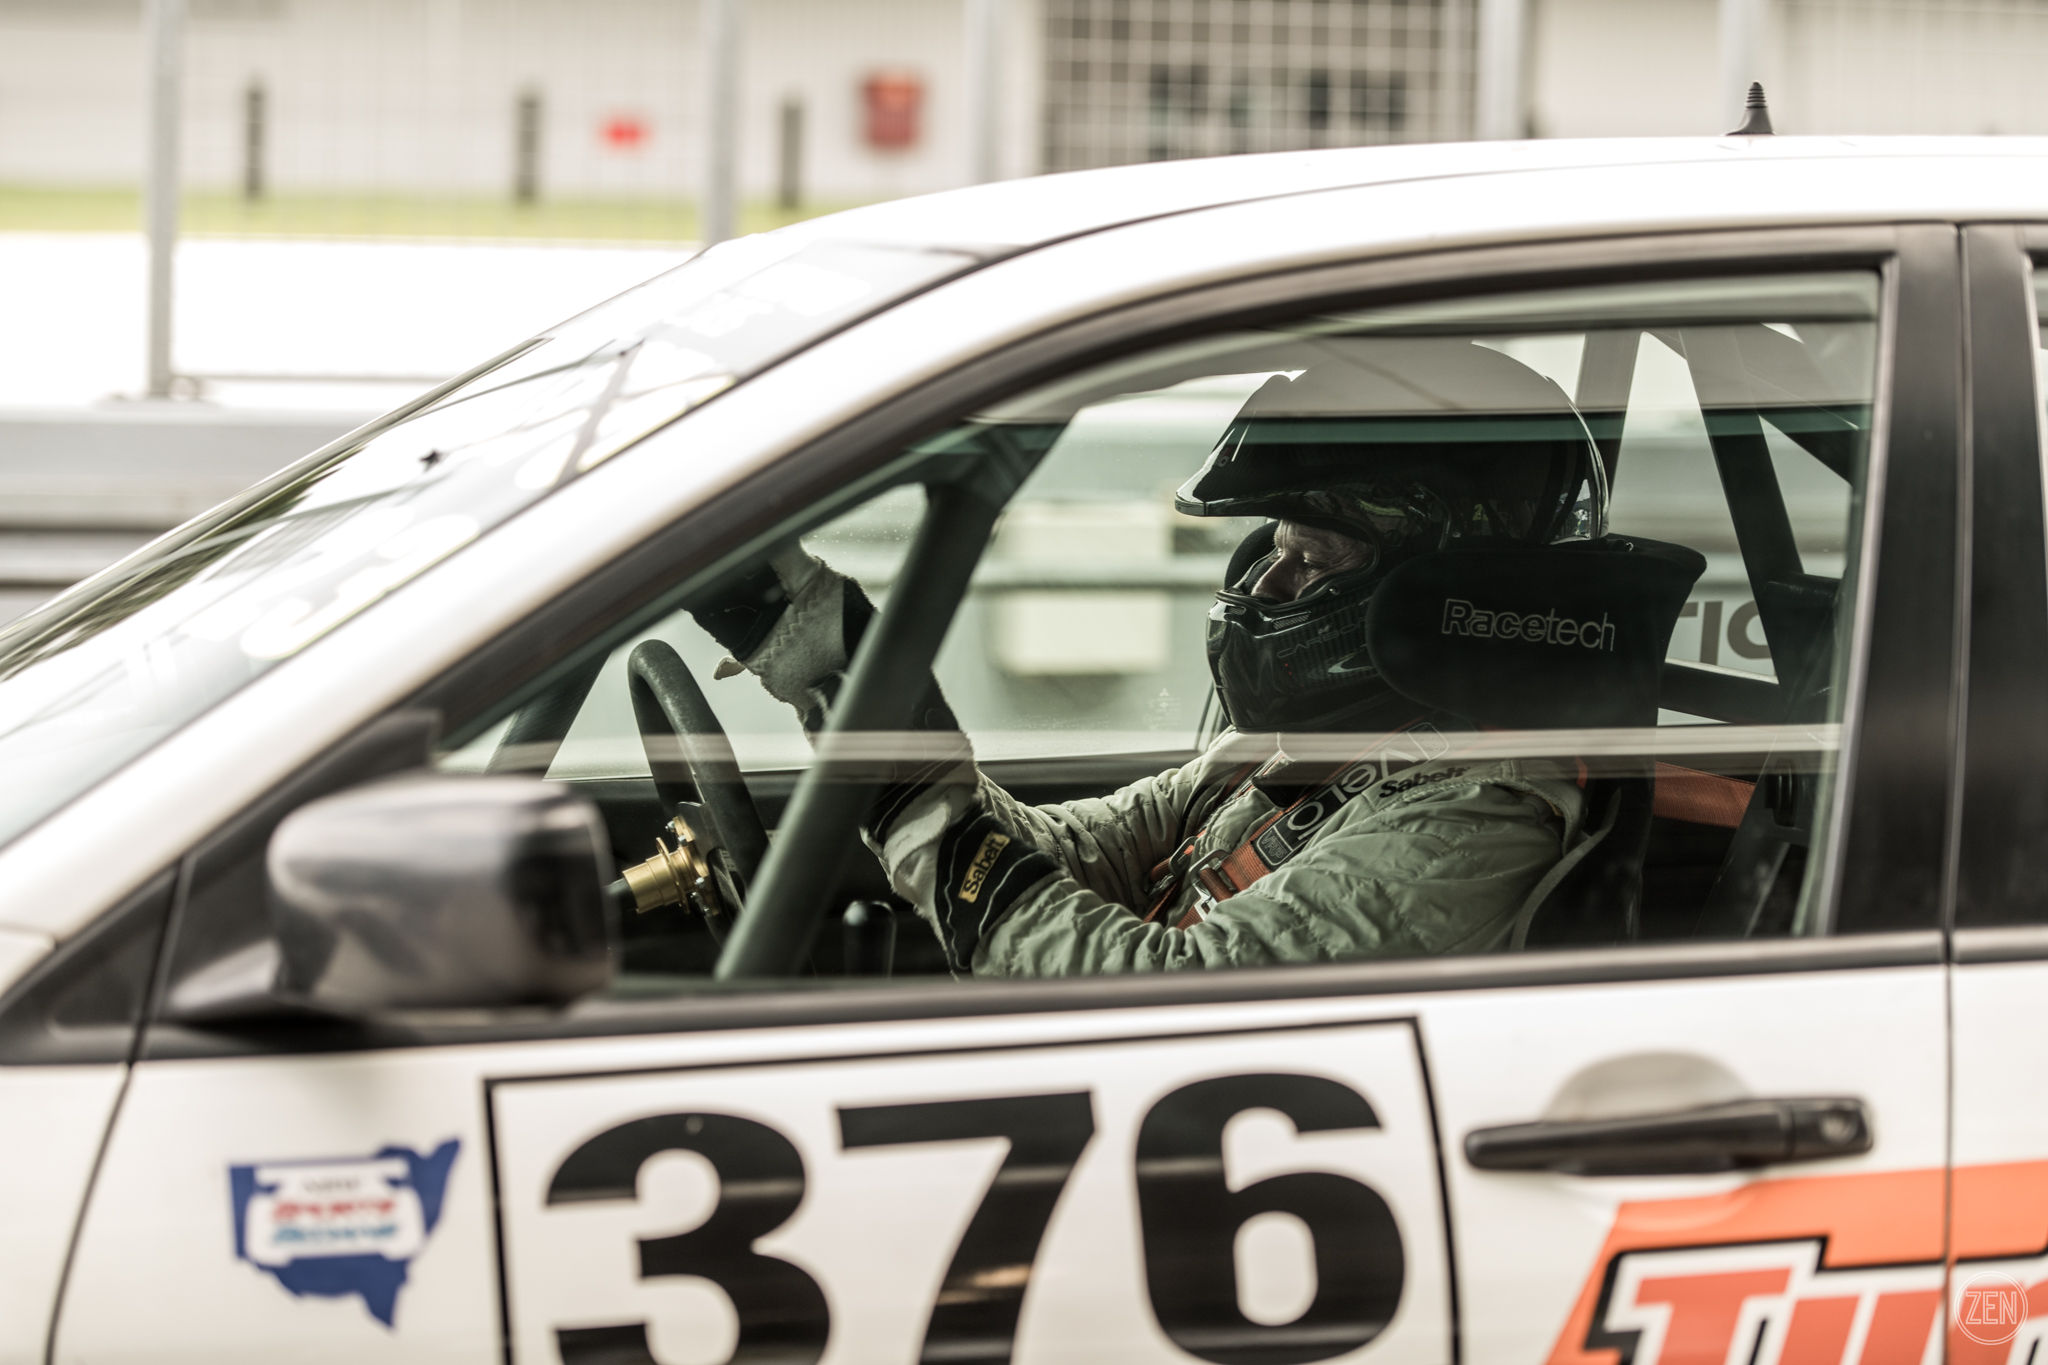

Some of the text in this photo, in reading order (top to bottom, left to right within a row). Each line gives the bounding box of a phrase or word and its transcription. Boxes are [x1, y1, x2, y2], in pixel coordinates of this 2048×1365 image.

[1441, 599, 1615, 651] Racetech
[1379, 767, 1467, 798] Sabelt
[963, 838, 1005, 895] Sabelt
[544, 1072, 1406, 1365] 376
